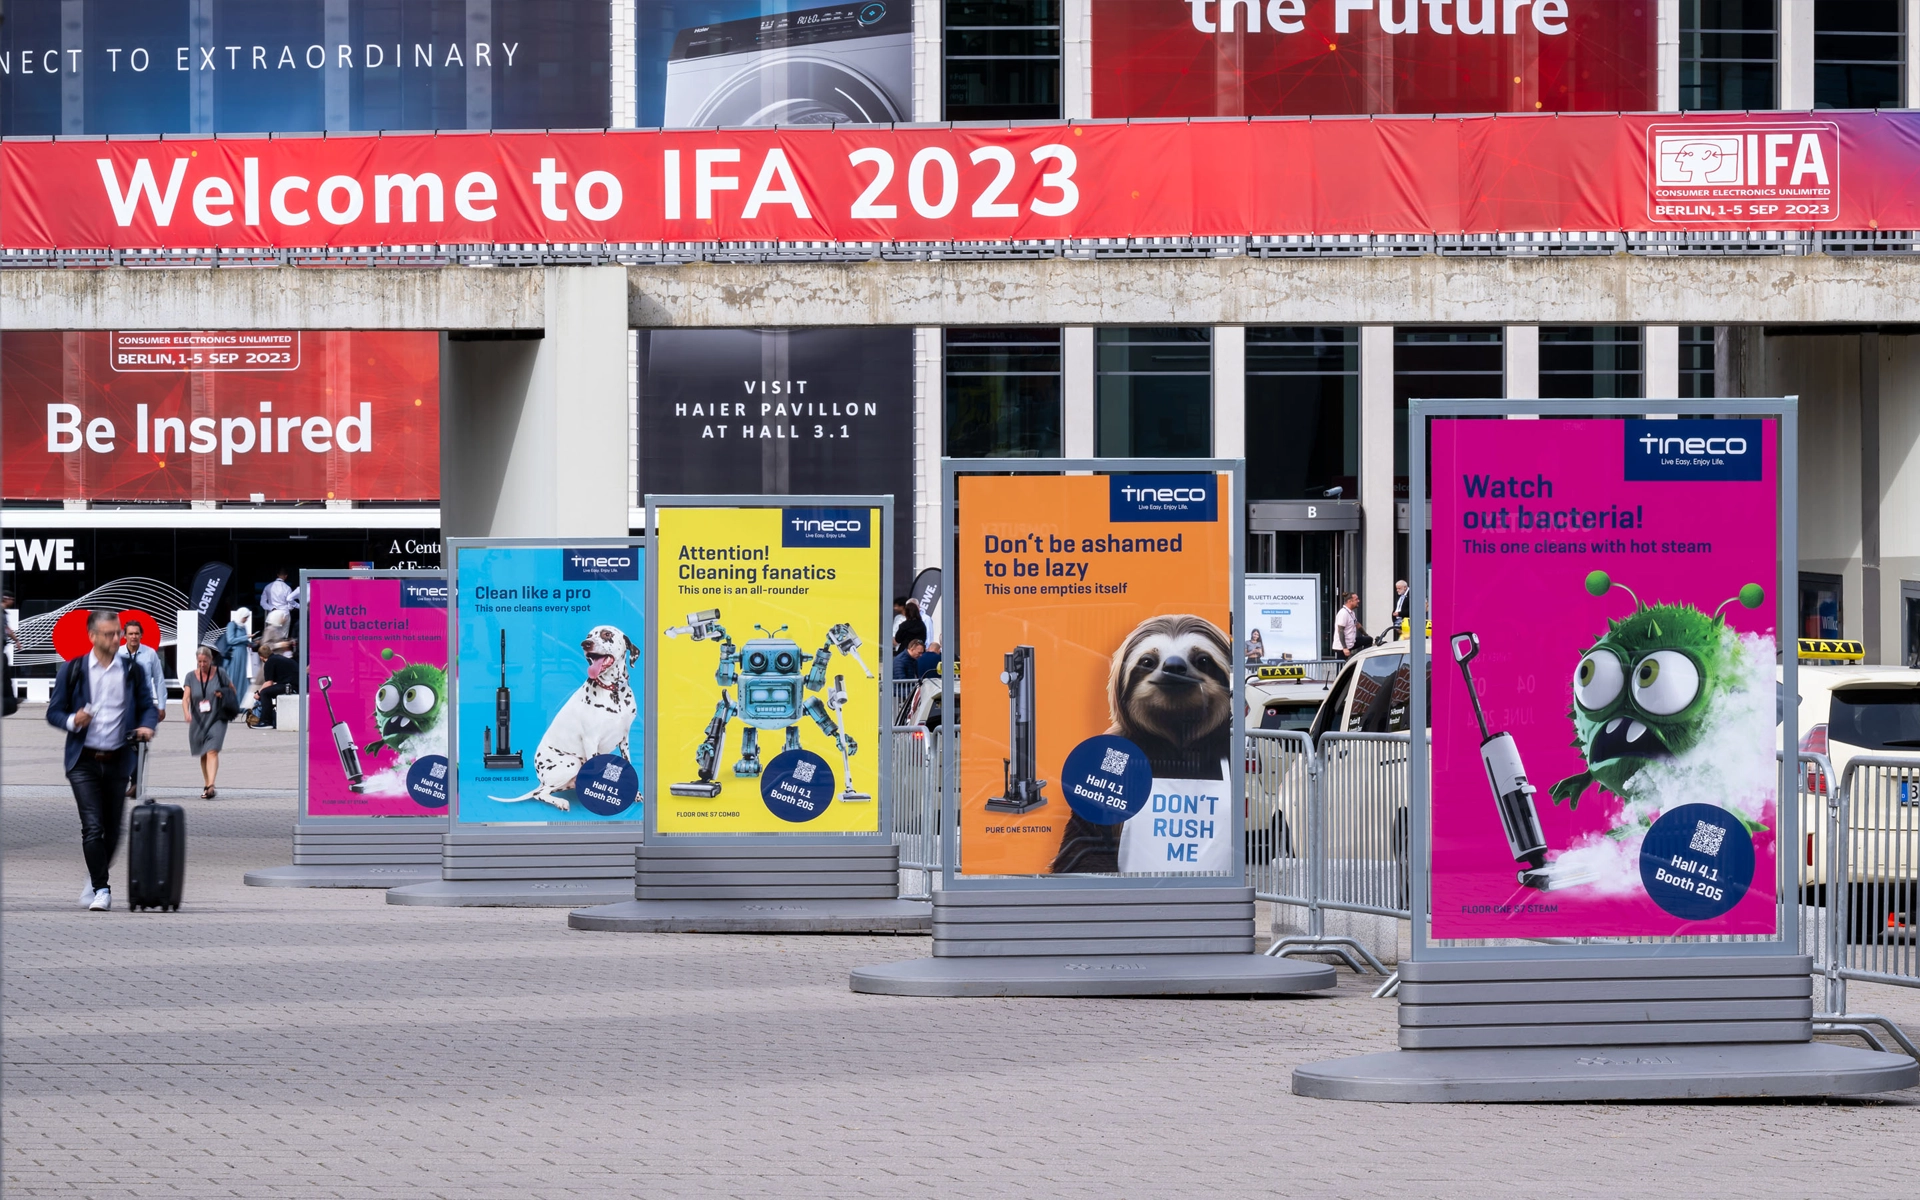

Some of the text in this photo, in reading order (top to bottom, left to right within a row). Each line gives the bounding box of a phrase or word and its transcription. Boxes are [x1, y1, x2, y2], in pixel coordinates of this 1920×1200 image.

[1335, 0, 1569, 35] Future
[106, 48, 150, 72] TO
[177, 42, 519, 71] EXTRAORDINARY
[1747, 133, 1830, 186] IFA
[96, 144, 1080, 227] Welcome to IFA 2023
[1655, 188, 1831, 197] CONSUMER ELECTRONICS UNLIMITED
[1655, 204, 1830, 216] BERLIN, 1-5 SEP 2023
[118, 335, 292, 345] CONSUMER ELECTRONICS UNLIMITED
[117, 352, 291, 365] BERLIN, 1-5 SEP 2023
[744, 380, 807, 394] VISIT
[675, 402, 877, 416] HAIER PAVILLON
[47, 401, 372, 465] Be Inspired
[702, 424, 849, 438] AT HALL 3.1
[1661, 458, 1725, 467] Live Easy. Enjoy Life.
[1463, 474, 1553, 499] Watch
[1307, 506, 1317, 518] B
[1463, 504, 1643, 529] out bacteria!
[389, 539, 402, 554] A
[1050, 534, 1075, 553] be
[1081, 533, 1182, 553] ashamed
[1462, 538, 1712, 554] This one cleans with hot steam
[678, 545, 769, 561] Attention!
[678, 564, 836, 584] Cleaning fanatics
[984, 558, 1089, 581] to be lazy
[196, 577, 221, 615] LOEWE.
[475, 586, 591, 602] Clean like a pro
[678, 585, 809, 595] This one is an all-rounder
[984, 582, 1128, 597] This one empties itself
[324, 604, 367, 616] Watch
[475, 604, 591, 614] This one cleans every spot
[324, 618, 409, 630] out bacteria!
[1806, 641, 1855, 653] TAXI
[1266, 667, 1299, 676] TAXI
[413, 783, 446, 800] Booth 205
[421, 777, 444, 791] Hall 4.1
[592, 780, 619, 796] Hall 4.1
[780, 781, 811, 799] Hall 4.1
[1085, 774, 1124, 796] Hall 4.1
[583, 787, 622, 806] Booth 205
[770, 789, 815, 812] Booth 205
[1073, 784, 1128, 811] Booth 205
[985, 826, 1005, 834] PURE
[1022, 825, 1052, 833] STATION
[1153, 818, 1214, 839] RUSH
[1167, 842, 1199, 863] ME
[1671, 854, 1719, 882] Hall 4.1
[1655, 867, 1724, 901] Booth 205
[1461, 904, 1558, 914] FLOOR ONE S7 STEAM
